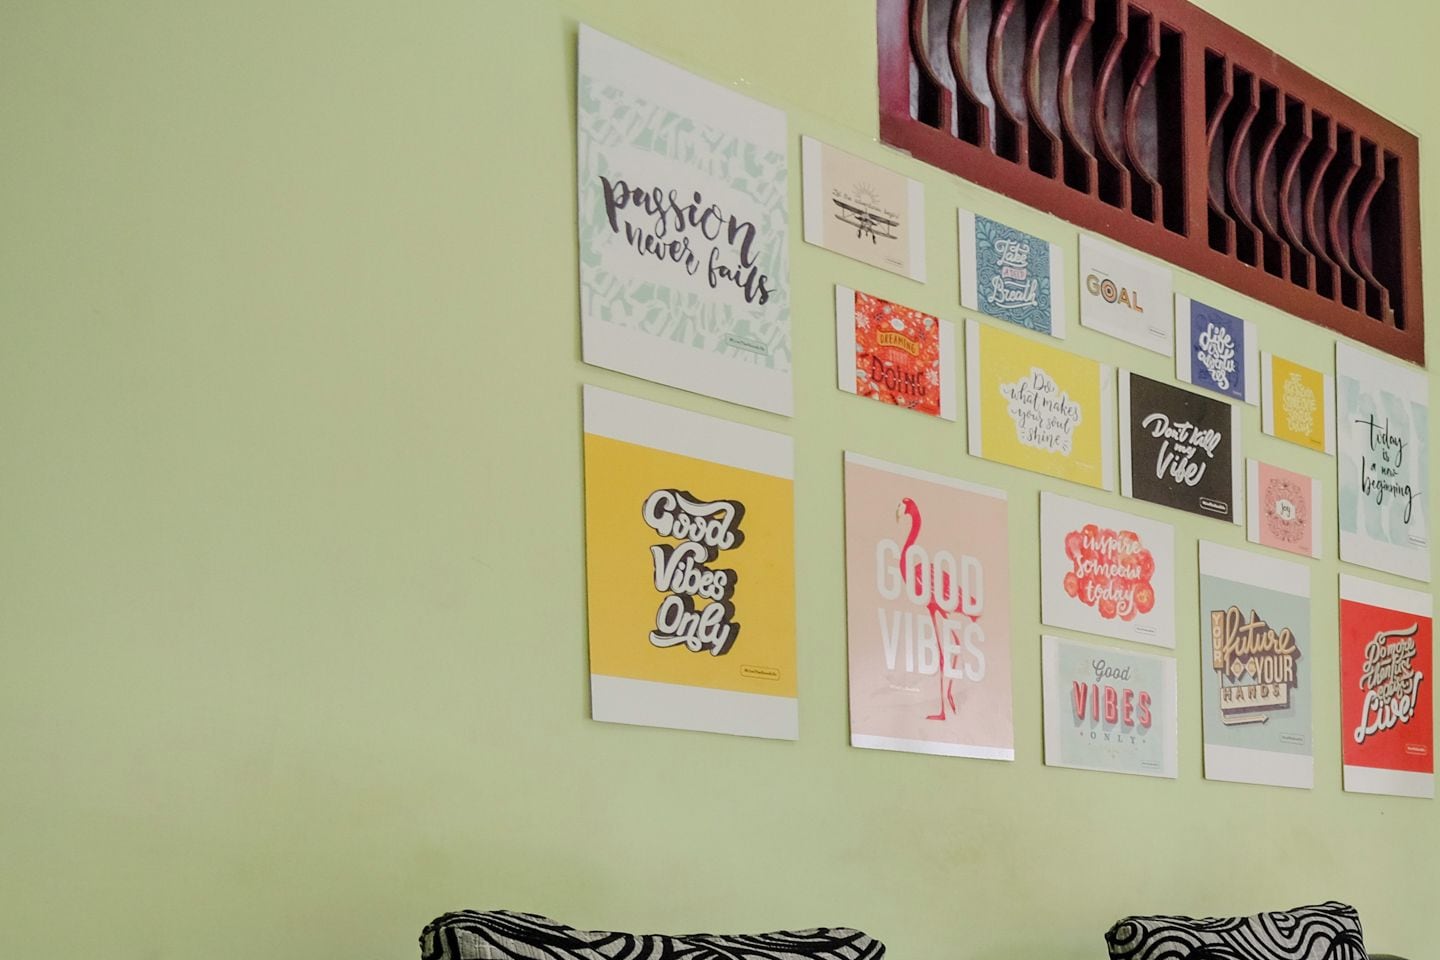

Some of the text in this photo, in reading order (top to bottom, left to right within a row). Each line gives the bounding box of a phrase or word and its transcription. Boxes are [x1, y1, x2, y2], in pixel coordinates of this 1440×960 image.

[598, 175, 760, 269] passion
[624, 220, 777, 305] never fails
[988, 276, 1038, 308] Breath
[1086, 274, 1144, 313] GOAL
[871, 355, 927, 396] DOING
[1033, 372, 1054, 393] Do
[1003, 382, 1079, 422] what makes
[1011, 408, 1043, 429] your
[1027, 426, 1061, 448] shine
[1173, 443, 1197, 459] my
[642, 489, 744, 550] Good
[1082, 535, 1141, 560] inspire
[650, 541, 735, 601] Vibes
[877, 539, 984, 615] GOOD
[1086, 580, 1136, 616] today
[650, 595, 738, 657] Only
[878, 607, 986, 682] VIBES
[1213, 612, 1224, 667] YOUR
[1222, 605, 1297, 676] future
[1092, 659, 1132, 683] Good
[1254, 655, 1294, 684] YOUR
[1072, 680, 1152, 729] VIBES
[1223, 684, 1281, 702] HANDS
[1090, 731, 1137, 745] ONLY
